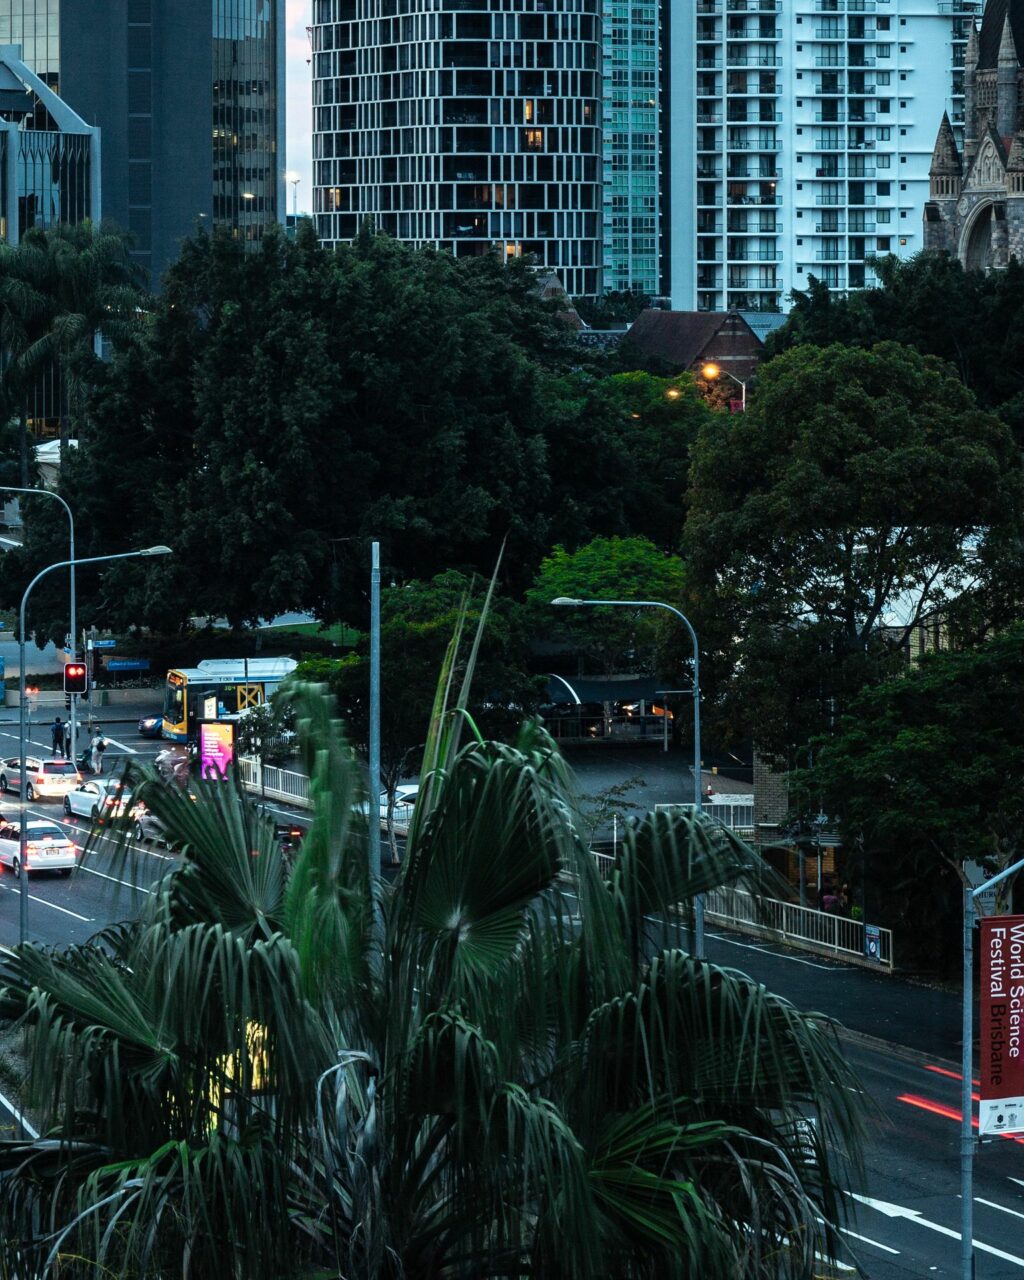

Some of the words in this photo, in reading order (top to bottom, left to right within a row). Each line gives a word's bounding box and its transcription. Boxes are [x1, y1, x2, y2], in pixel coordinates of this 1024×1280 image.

[990, 927, 1007, 998] Festival
[1009, 923, 1024, 979] World
[990, 1004, 1007, 1086] Brisbane
[1009, 985, 1024, 1058] Science
